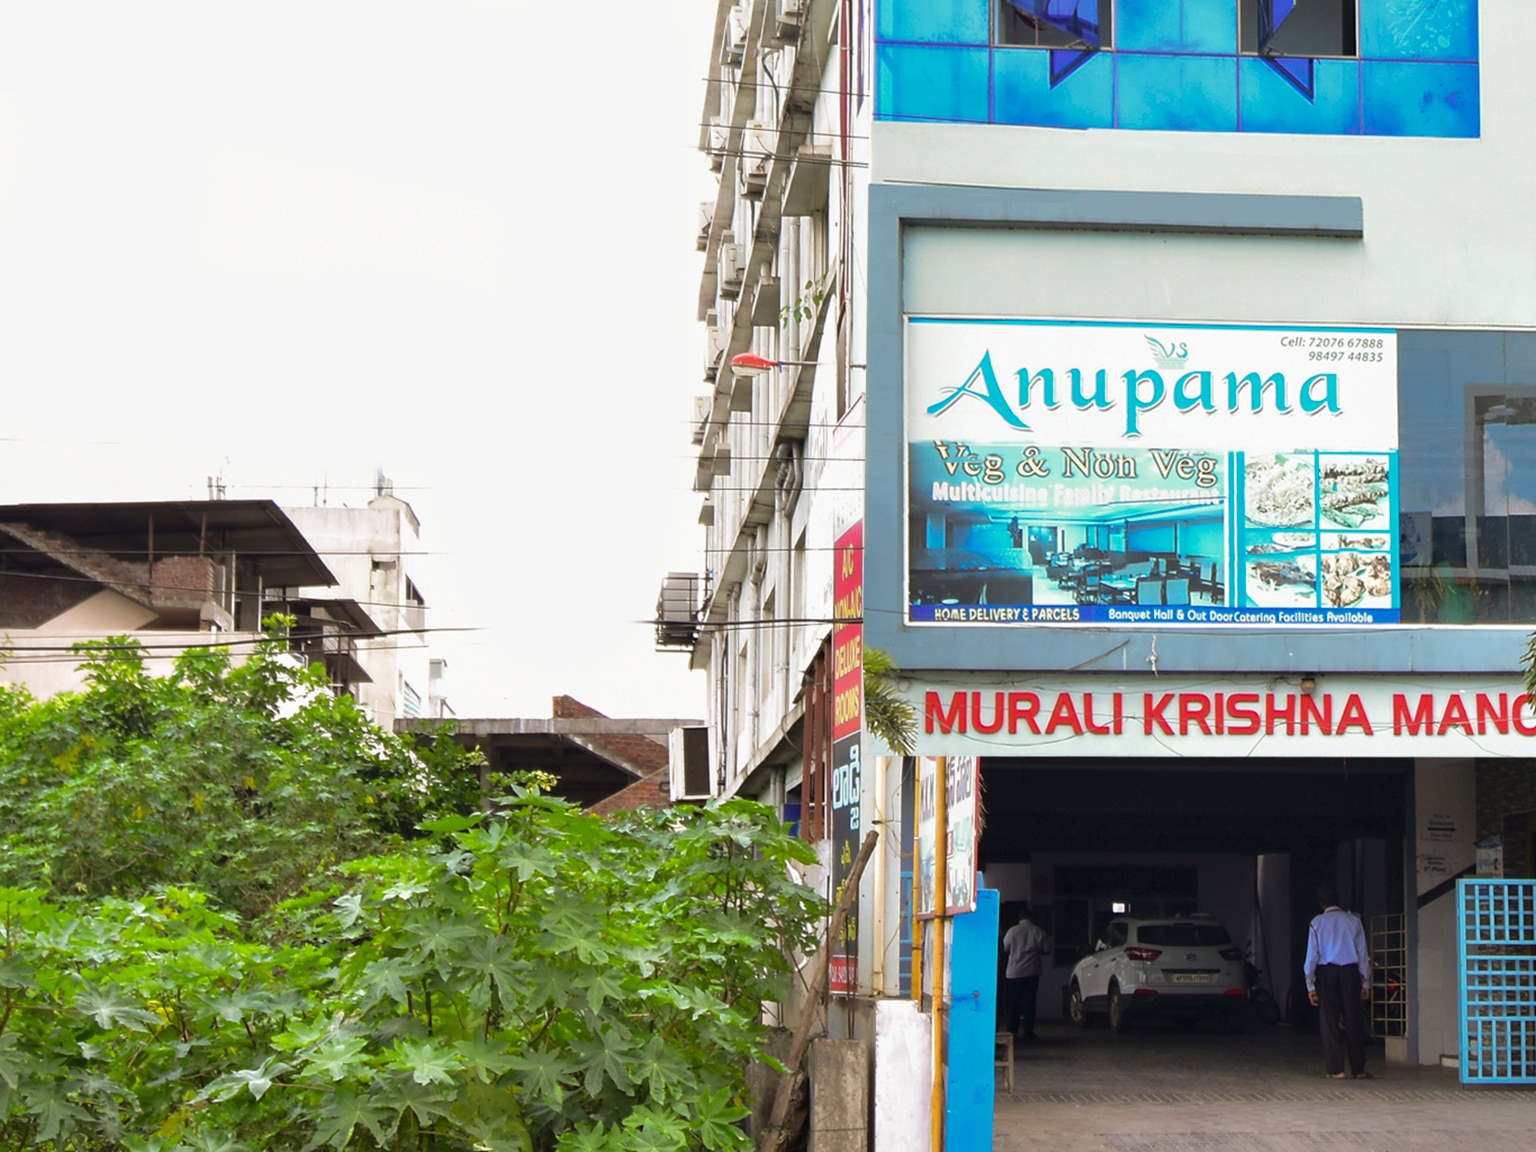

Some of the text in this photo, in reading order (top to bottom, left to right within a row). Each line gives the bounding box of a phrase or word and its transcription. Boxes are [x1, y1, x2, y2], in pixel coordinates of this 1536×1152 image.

[1280, 336, 1383, 348] Cell: 72076 67888
[1308, 351, 1383, 362] 98497 44835
[926, 348, 1343, 438] Anupama
[934, 440, 1218, 488] Veg & Non Veg
[932, 482, 1048, 506] Multicuisine
[1054, 484, 1115, 507] Family
[934, 608, 966, 621] HOME
[969, 608, 1018, 621] DELIVERY
[1032, 608, 1079, 621] PARCELS
[1109, 609, 1150, 622] Banquet
[1154, 609, 1173, 621] Hall
[1176, 610, 1184, 621] &
[1187, 610, 1207, 621] Out
[1279, 611, 1324, 623] Facilities
[1327, 611, 1373, 623] Available
[835, 684, 860, 727] ROOMS
[925, 691, 1124, 736] MURALI
[1143, 692, 1373, 736] KRISHNA
